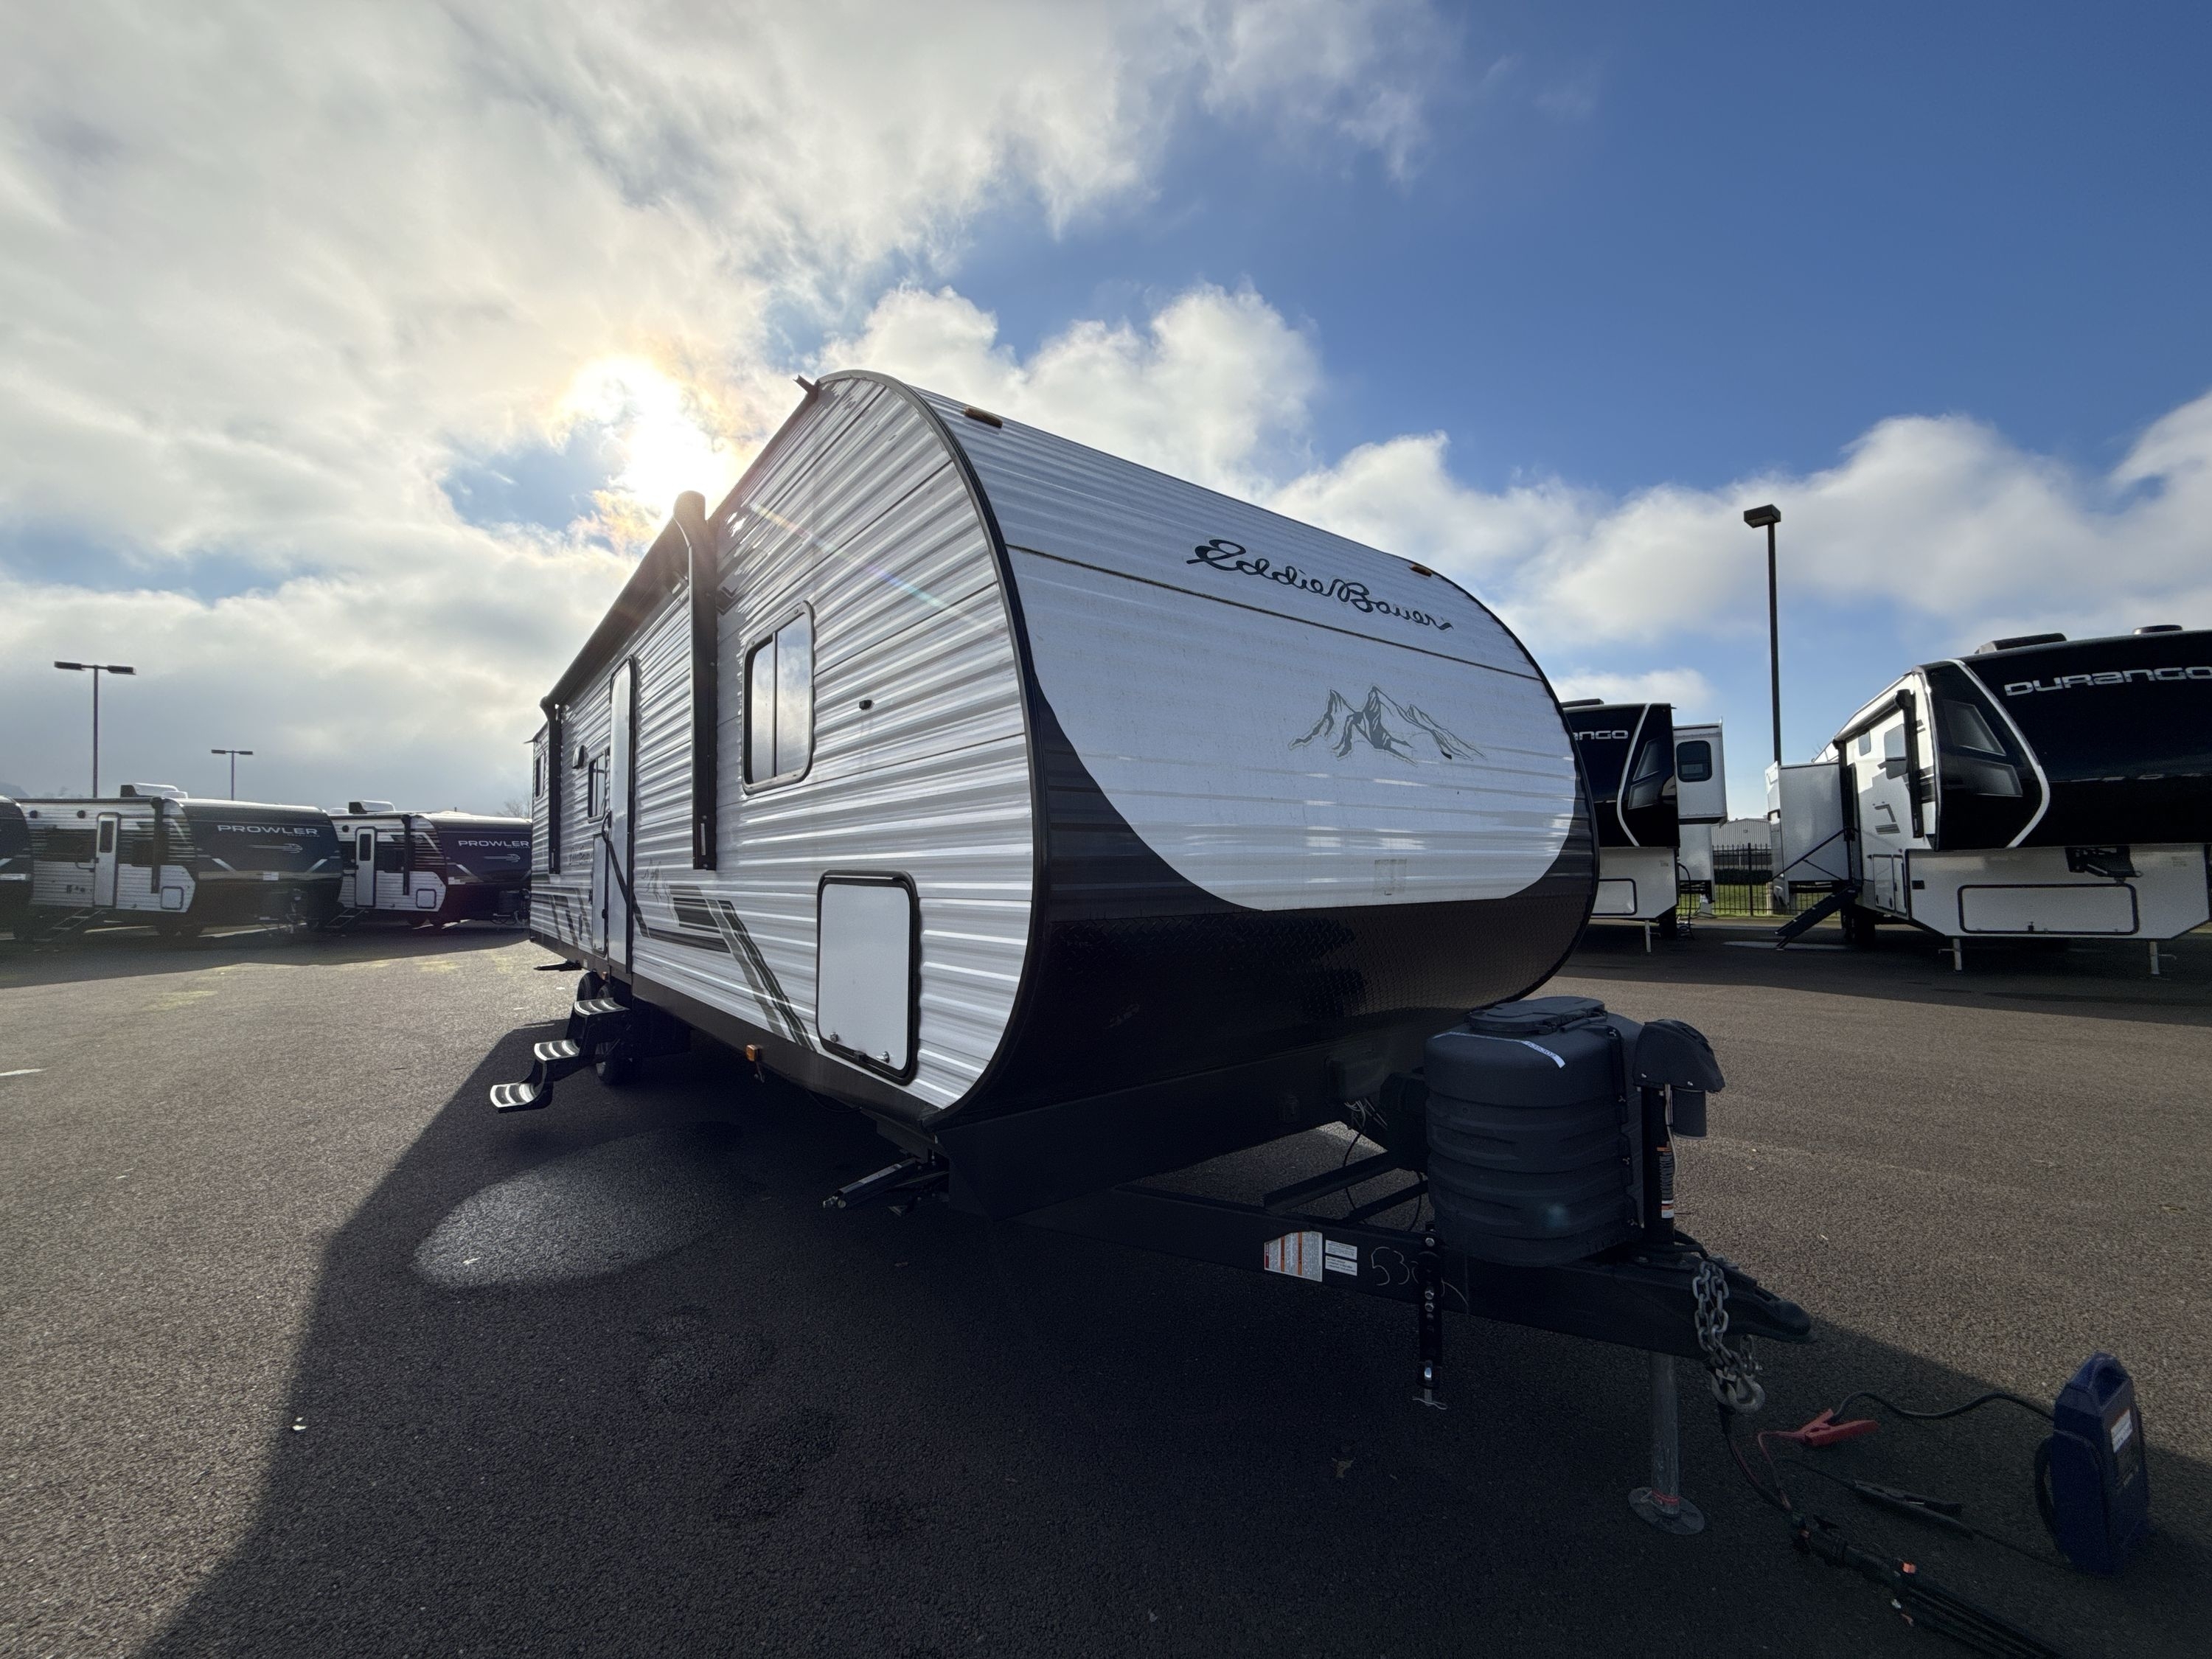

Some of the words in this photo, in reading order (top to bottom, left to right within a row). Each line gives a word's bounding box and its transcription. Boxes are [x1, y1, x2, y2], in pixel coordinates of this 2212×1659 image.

[1186, 539, 1329, 597] Eddie
[1328, 579, 1453, 630] Bauer
[2004, 666, 2212, 696] DURANGO
[217, 824, 319, 835] PROWLER
